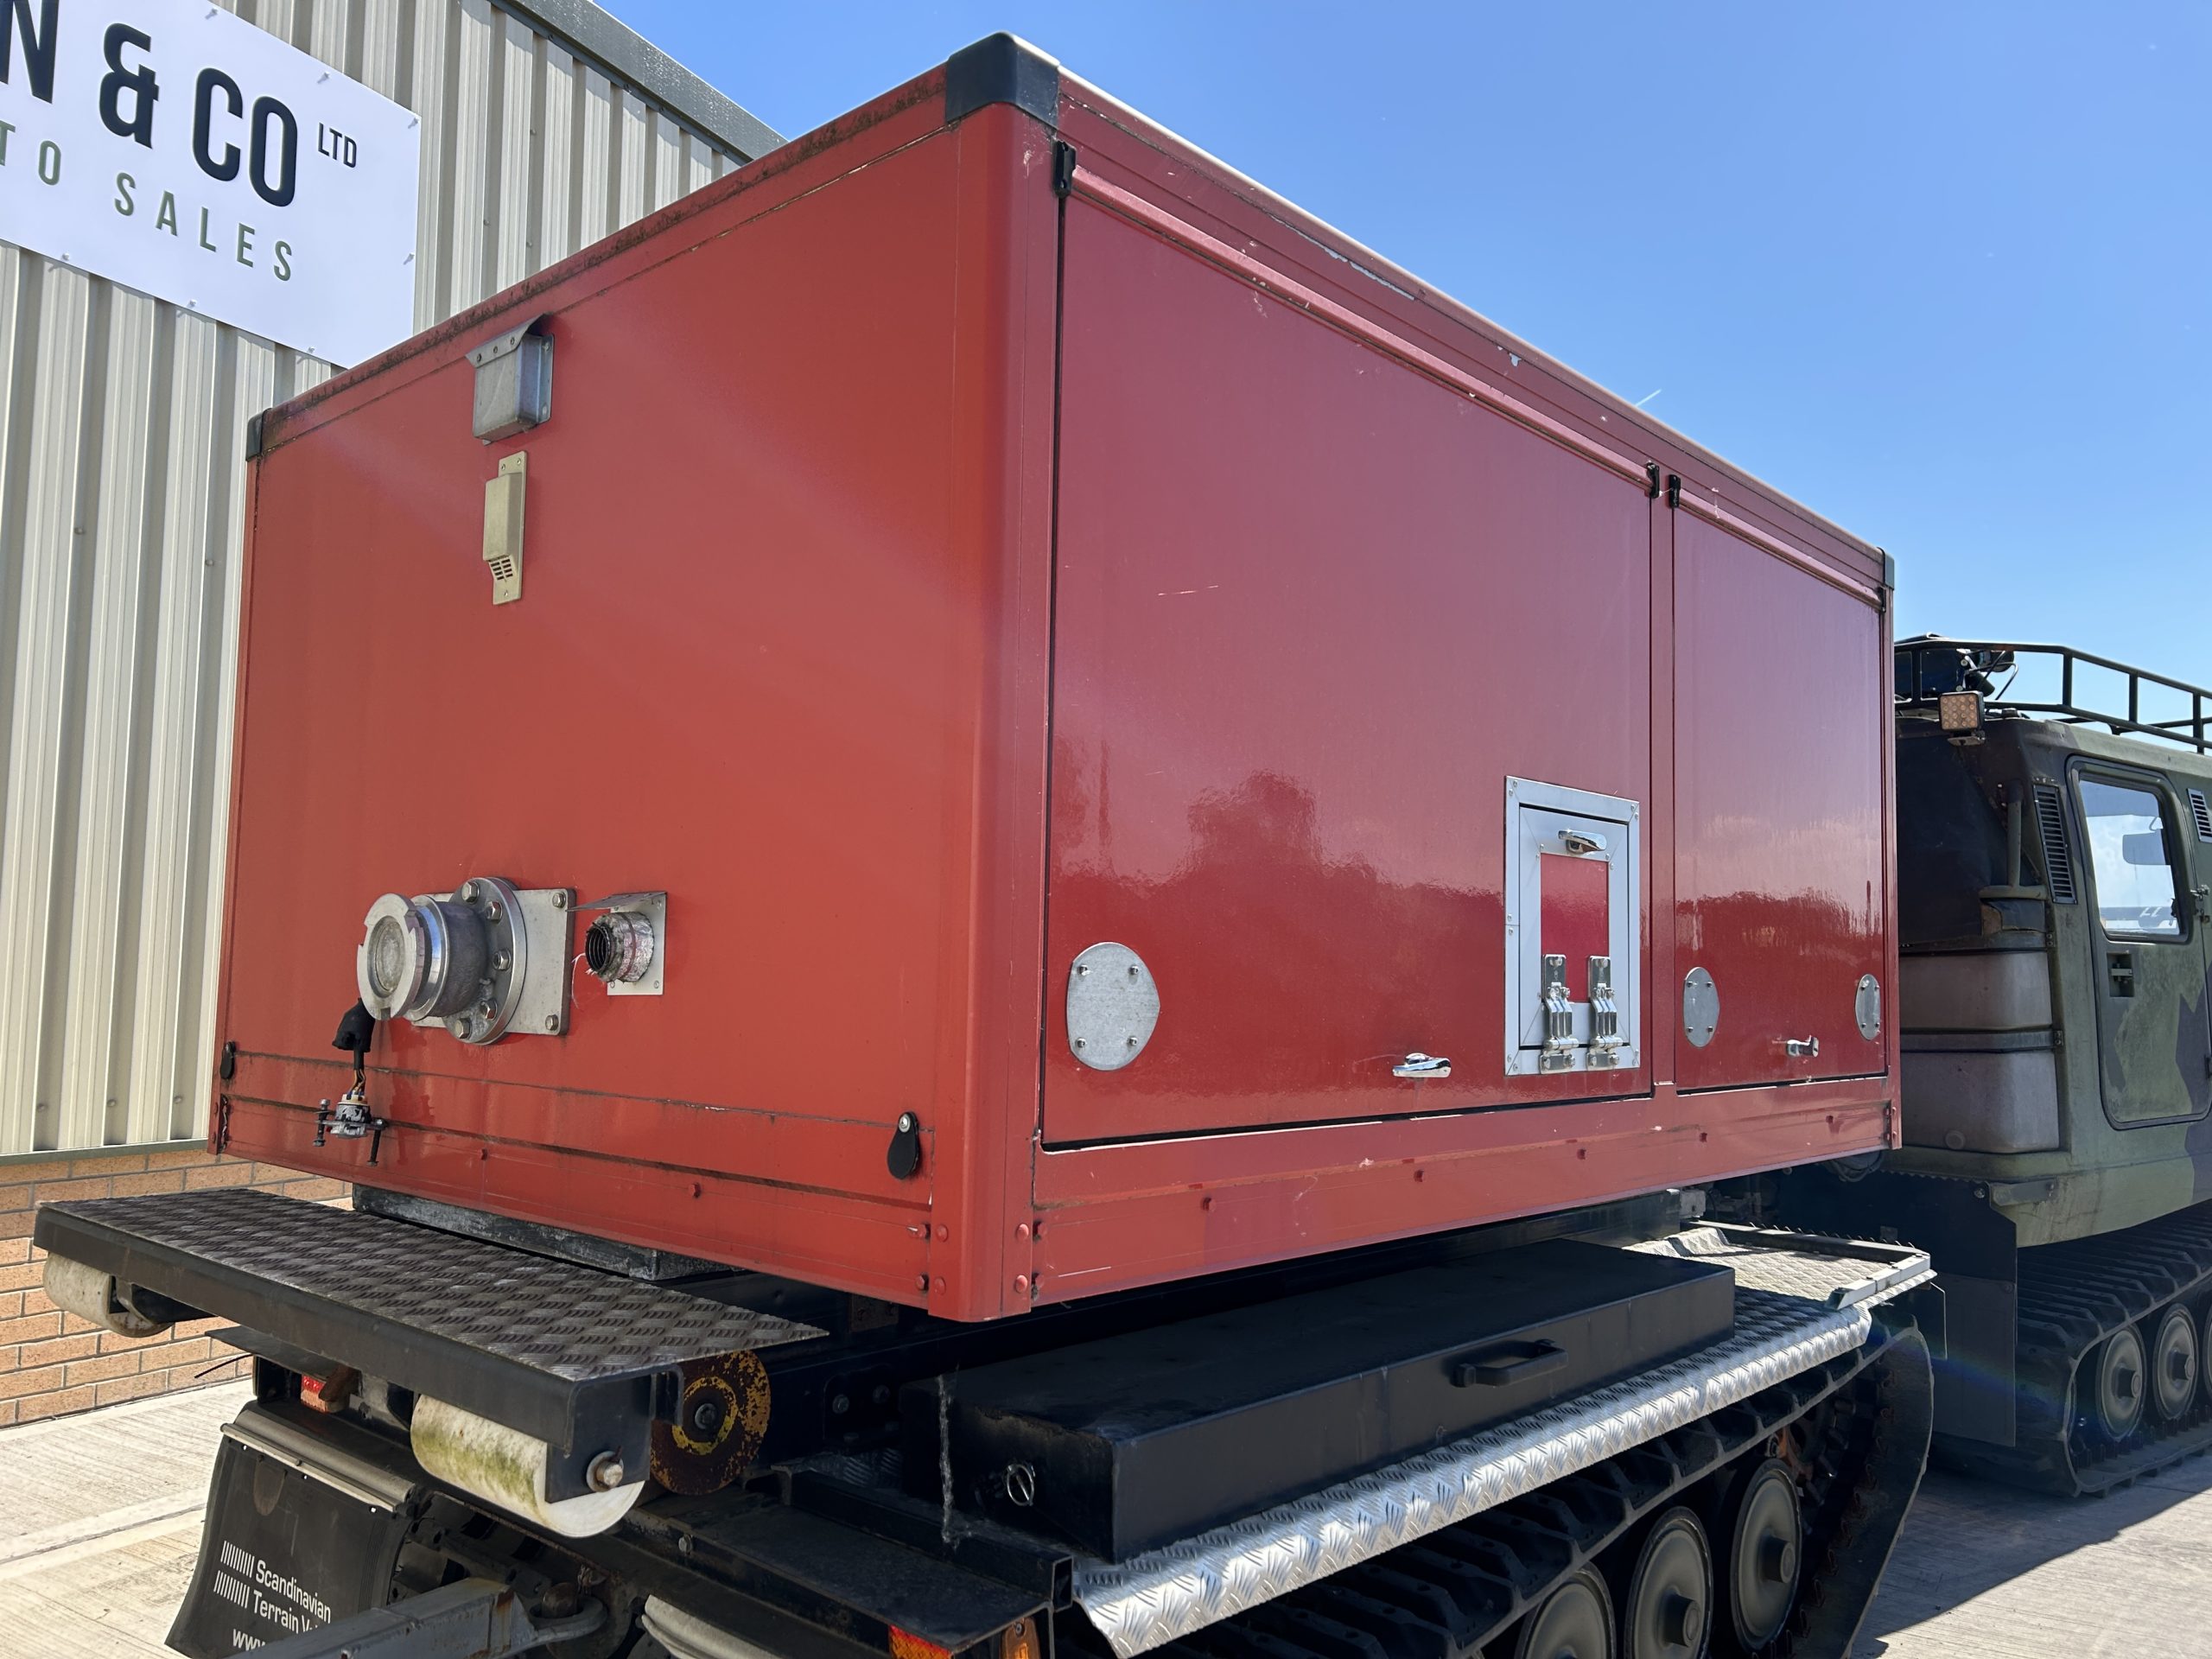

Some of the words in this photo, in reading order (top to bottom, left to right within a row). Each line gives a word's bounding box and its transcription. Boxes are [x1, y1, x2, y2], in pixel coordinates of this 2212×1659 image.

[99, 23, 159, 149] &
[193, 68, 297, 207] CO
[318, 123, 357, 168] LTD
[115, 173, 292, 281] SALES
[253, 1589, 299, 1634] Terrain
[256, 1560, 331, 1624] Scandinavian
